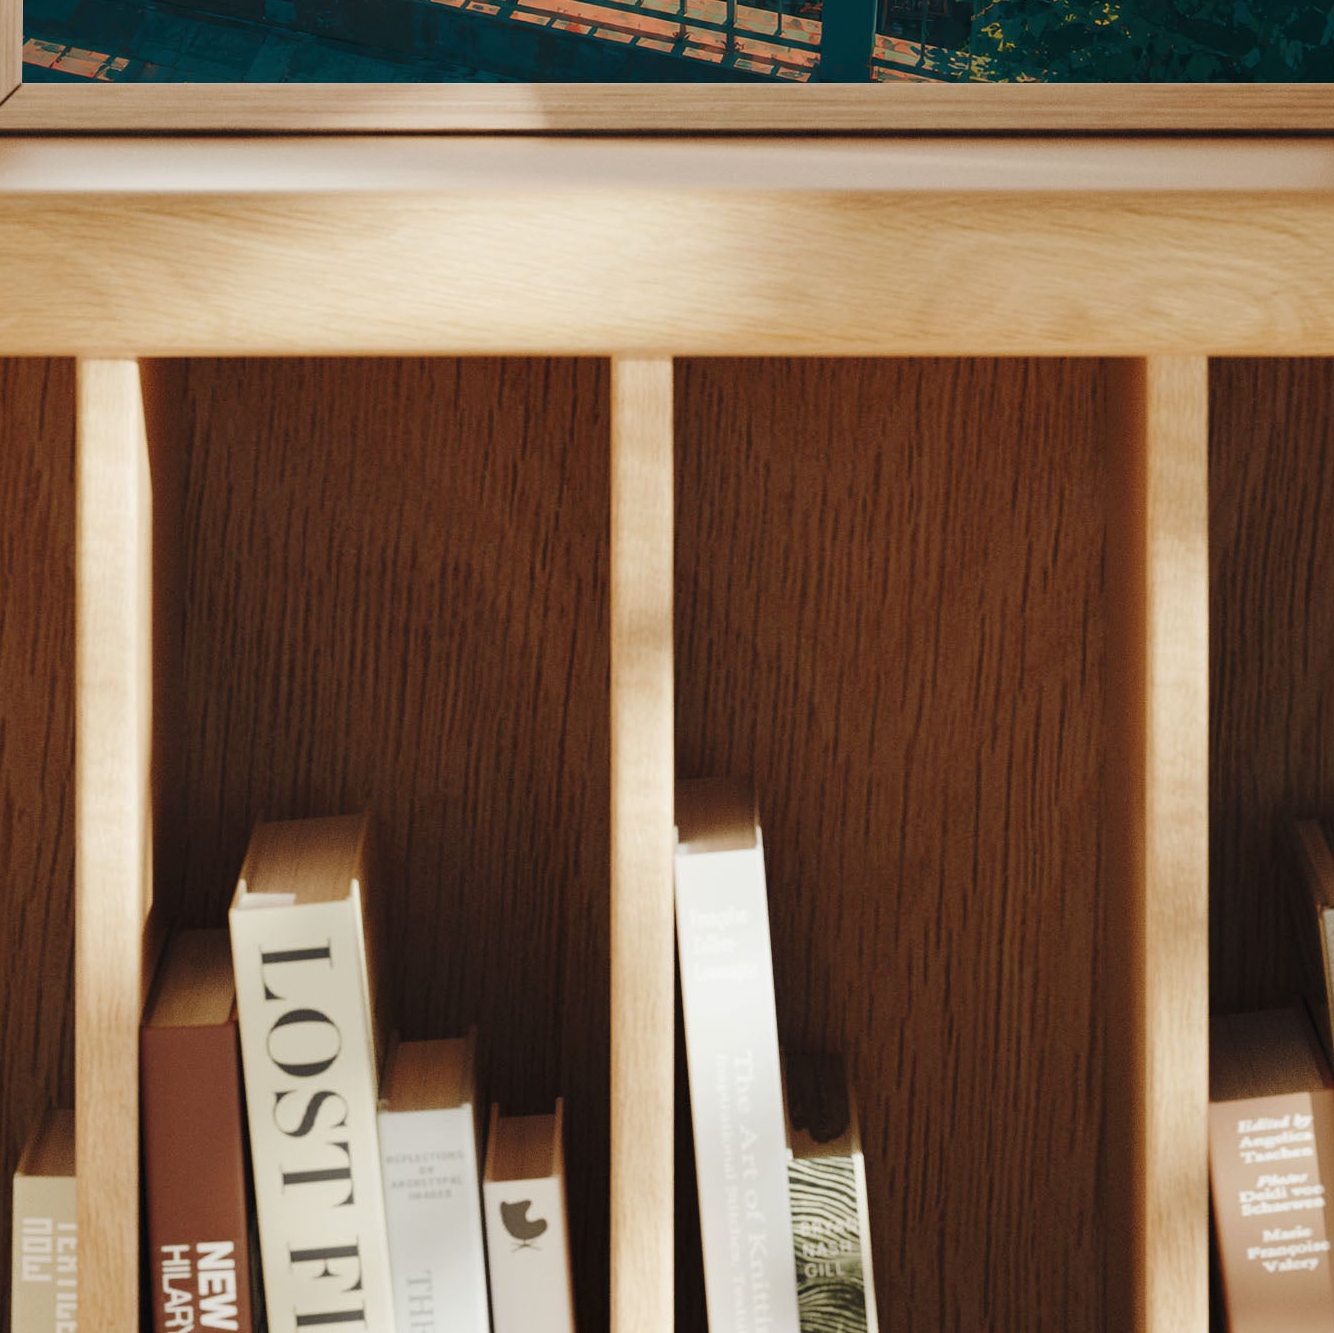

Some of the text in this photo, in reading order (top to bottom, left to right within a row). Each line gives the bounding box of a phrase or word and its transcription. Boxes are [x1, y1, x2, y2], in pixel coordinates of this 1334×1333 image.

[258, 938, 355, 1207] LOST
[734, 1050, 758, 1113] The
[740, 1125, 761, 1180] Art
[748, 1187, 769, 1224] of
[22, 1218, 53, 1283] NOW
[804, 1260, 845, 1279] GILL
[197, 1241, 239, 1331] NEW
